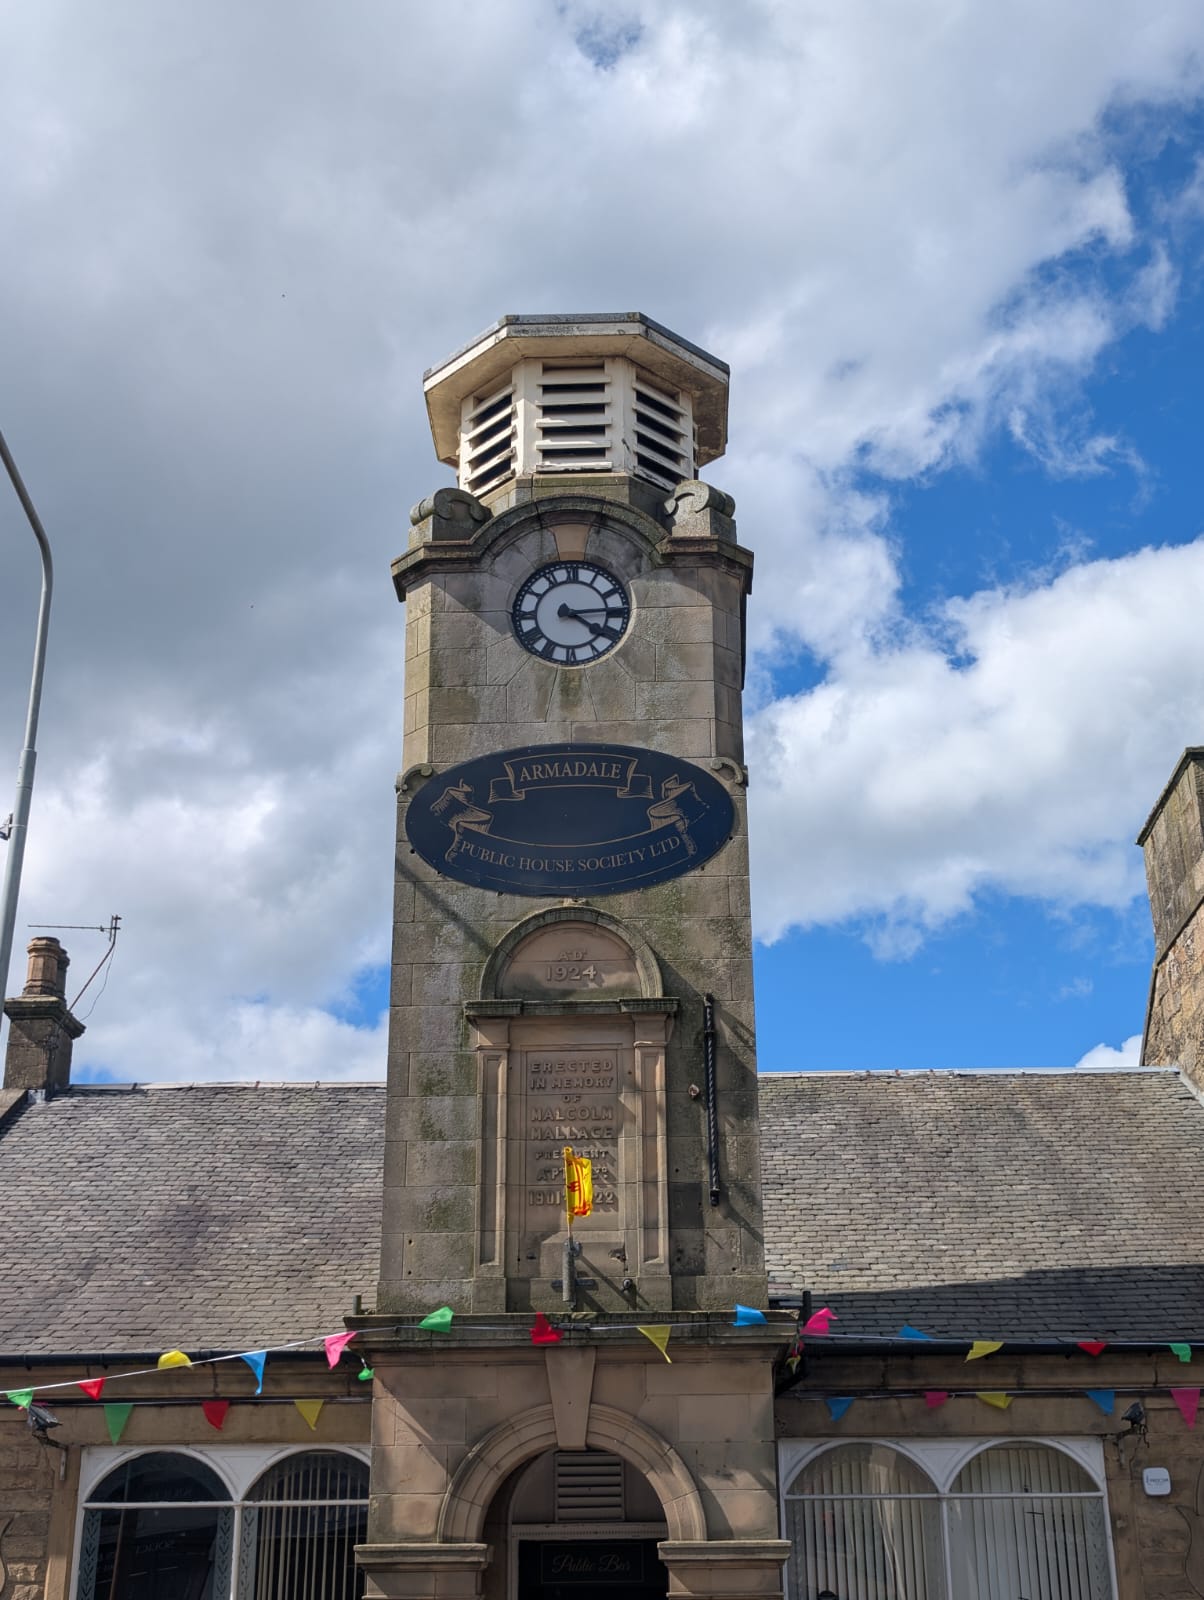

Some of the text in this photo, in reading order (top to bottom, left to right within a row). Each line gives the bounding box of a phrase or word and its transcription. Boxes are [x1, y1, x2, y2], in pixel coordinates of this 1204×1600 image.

[519, 761, 622, 783] ARMADALE
[460, 835, 681, 873] PUBLIC HOUSE SOCIETY LTD
[546, 964, 598, 982] 1924
[530, 1060, 614, 1074] ERECTED
[530, 1077, 614, 1090] IN MEMORY
[563, 1095, 582, 1103] OF
[531, 1107, 614, 1121] MALCOLM
[552, 1553, 632, 1573] Public Bar
